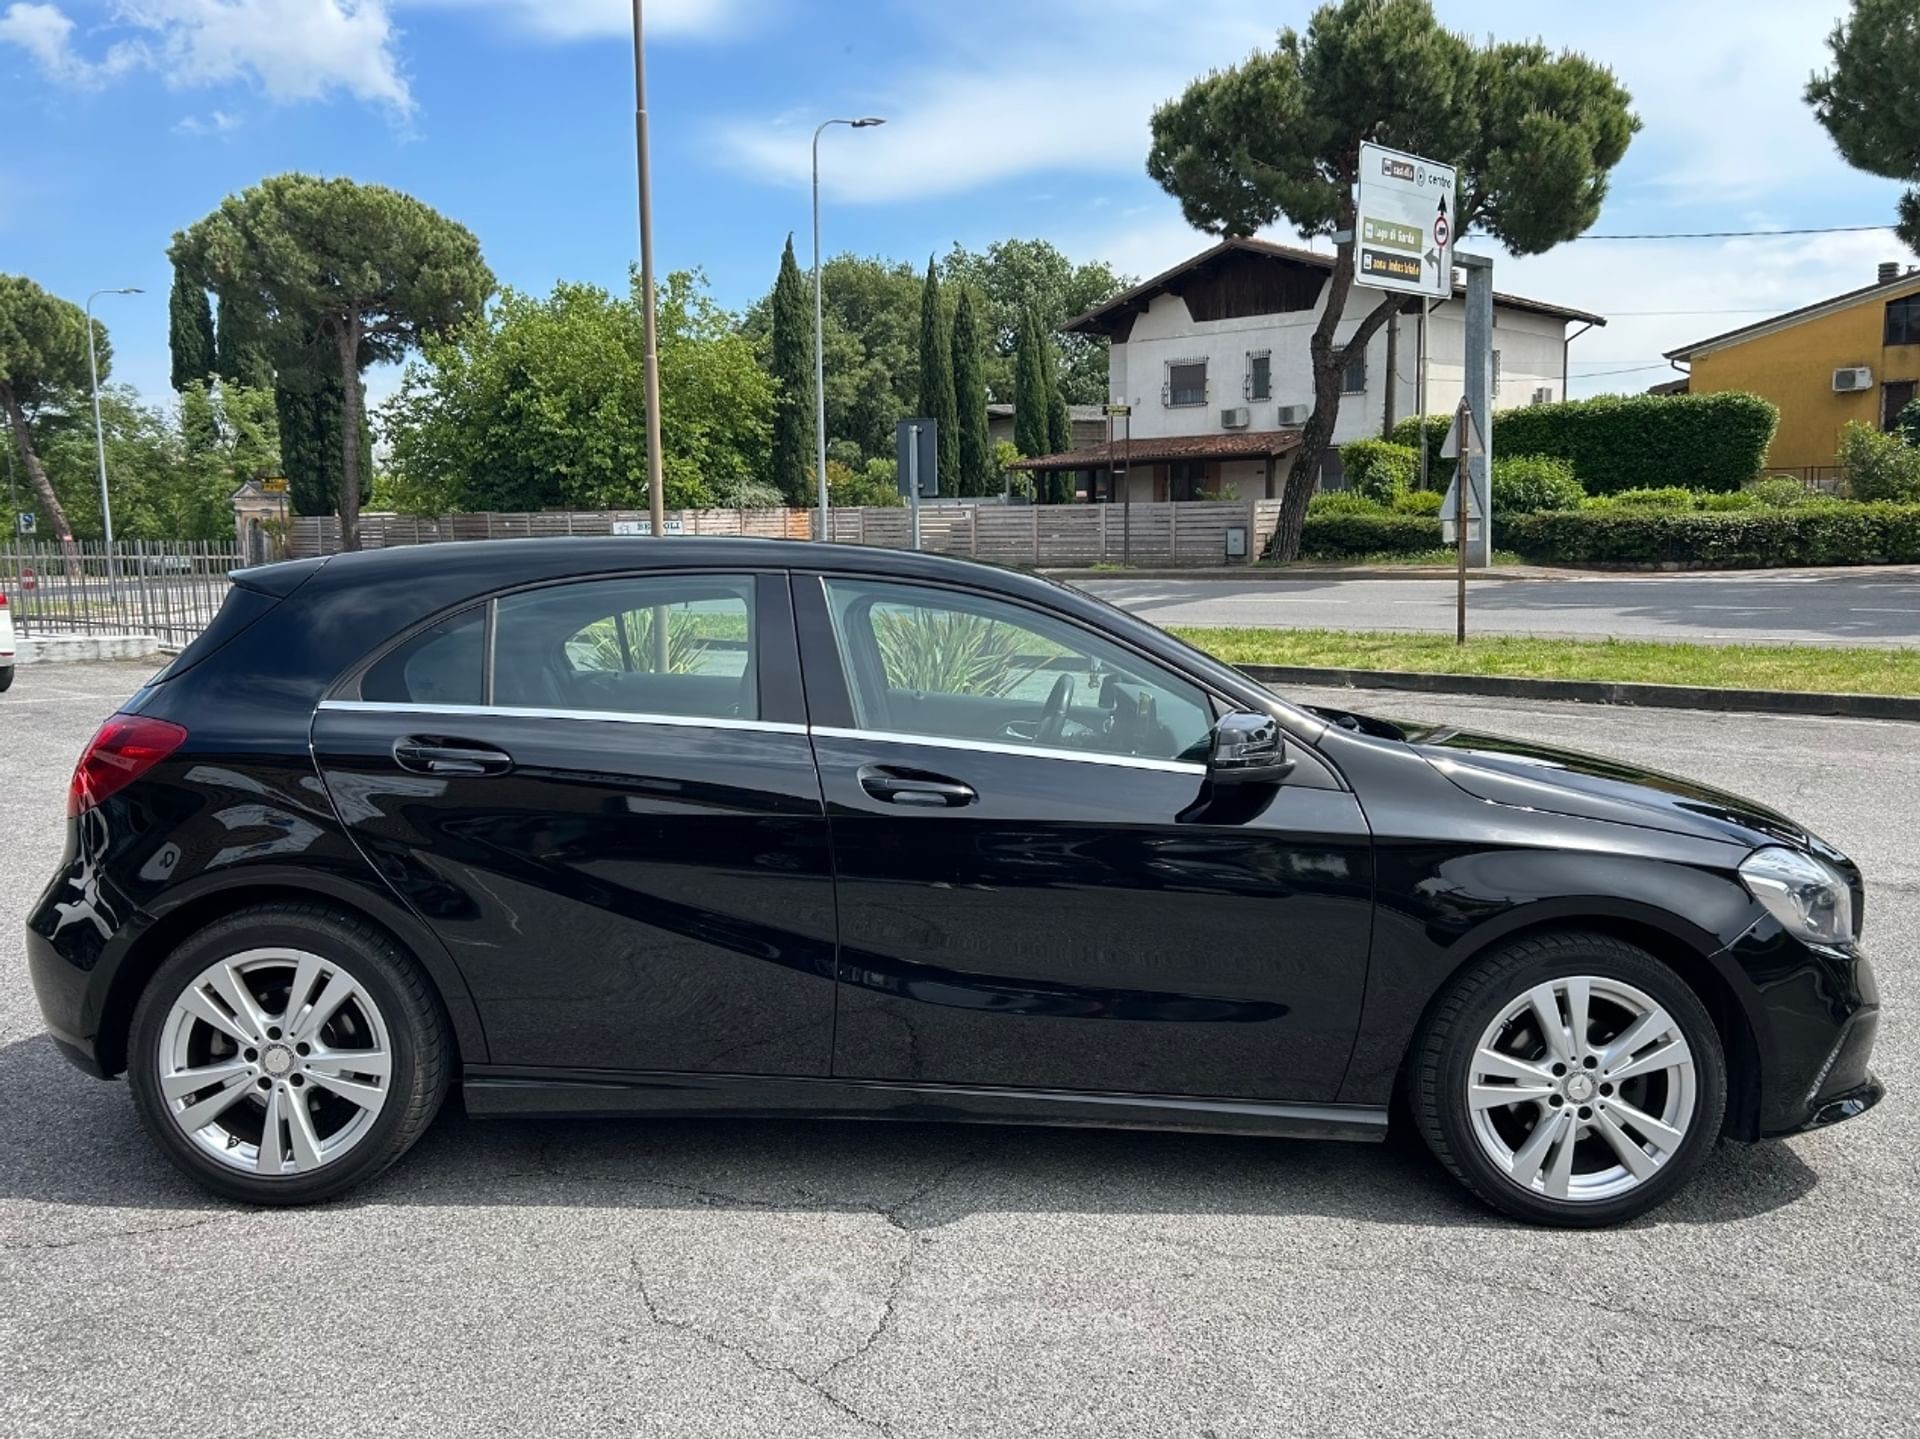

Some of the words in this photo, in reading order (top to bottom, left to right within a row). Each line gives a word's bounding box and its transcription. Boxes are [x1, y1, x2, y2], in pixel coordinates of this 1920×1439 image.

[1428, 174, 1452, 189] centro
[1398, 230, 1414, 244] Garda
[637, 522, 680, 530] BEOLI
